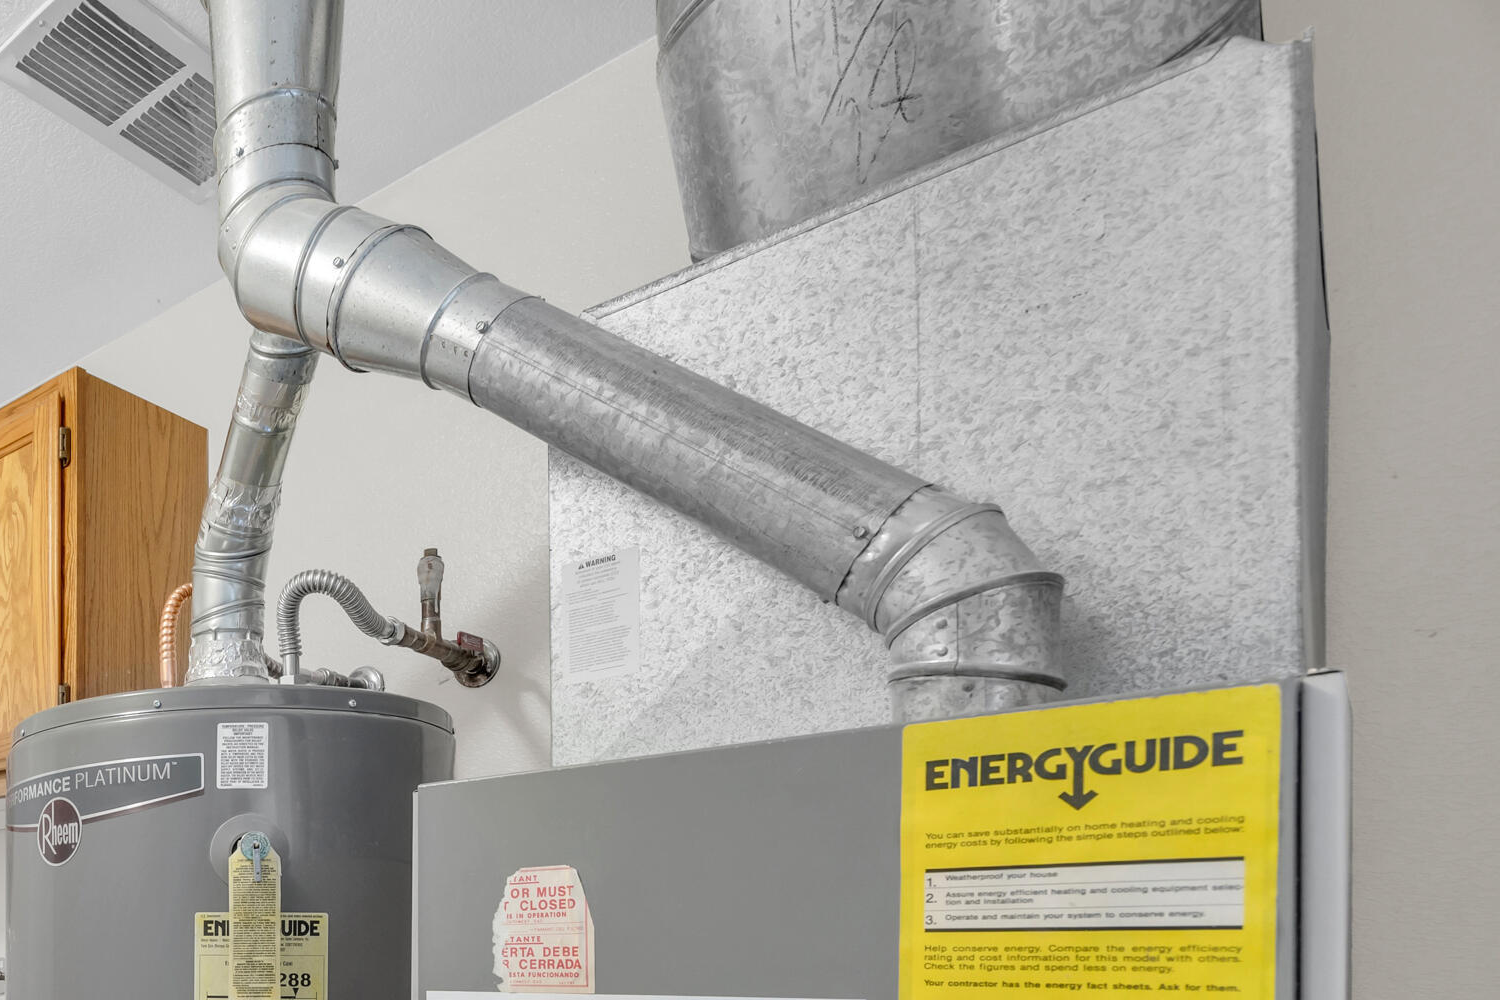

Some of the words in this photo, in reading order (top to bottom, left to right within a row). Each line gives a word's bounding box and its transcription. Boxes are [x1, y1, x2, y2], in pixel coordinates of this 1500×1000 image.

[585, 554, 616, 568] WARNING
[926, 730, 1244, 797] ENERGYGUIDE
[42, 800, 79, 855] Rheem
[967, 831, 992, 839] save
[992, 825, 1064, 838] substantially
[1083, 823, 1117, 834] home
[1120, 820, 1167, 832] heating
[1167, 817, 1192, 829] and
[1196, 815, 1245, 828] cooling
[537, 886, 574, 897] MUST
[520, 899, 576, 911] CLOSED
[543, 946, 579, 957] DEBE
[519, 959, 582, 970] CERRADA
